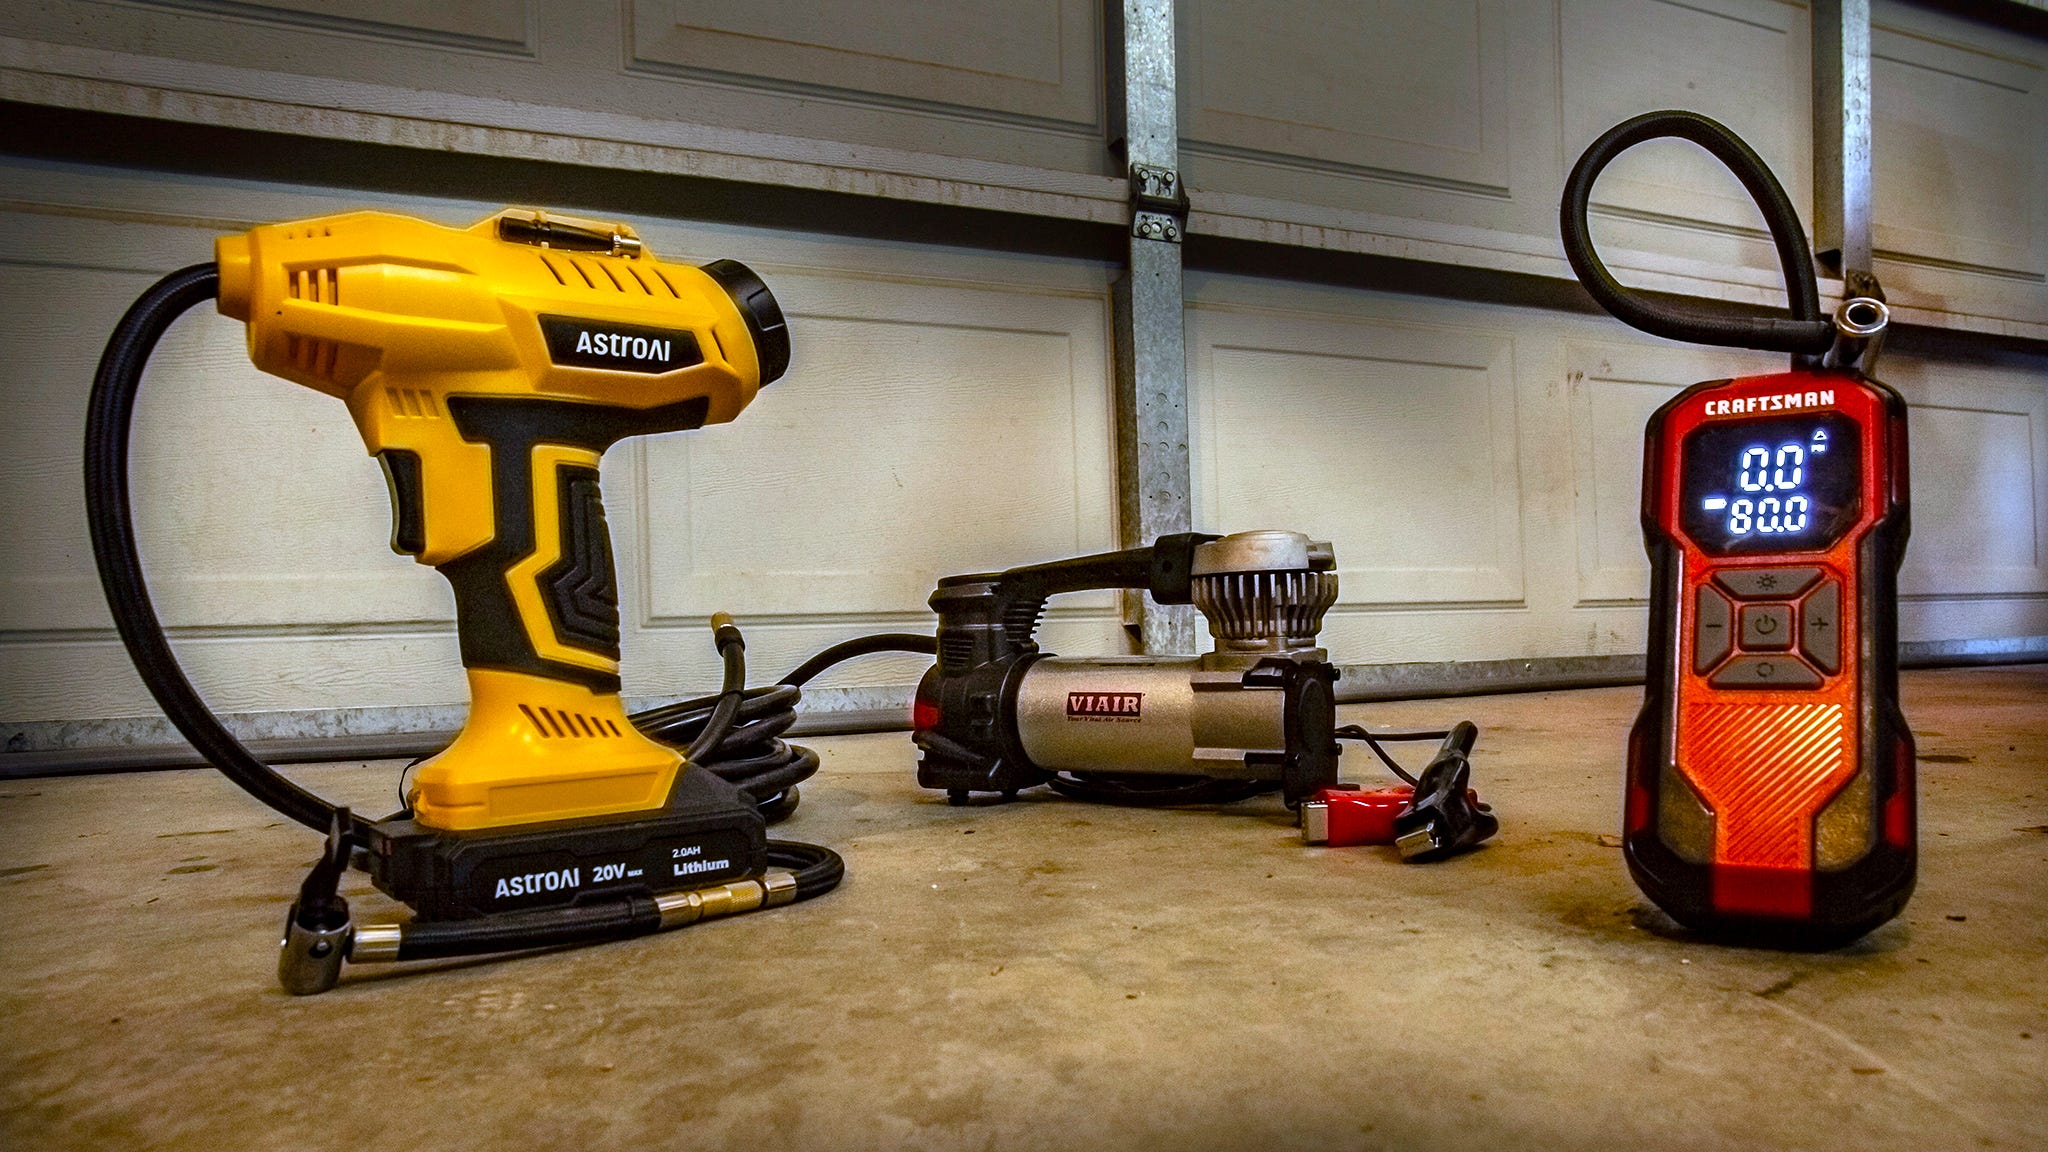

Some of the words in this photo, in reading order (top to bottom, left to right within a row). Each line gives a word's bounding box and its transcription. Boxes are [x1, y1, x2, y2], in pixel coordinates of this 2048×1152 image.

[1705, 390, 1835, 416] CRAFTSMAN
[1740, 445, 1804, 492] 0.0
[1070, 695, 1139, 713] VIAIR
[672, 845, 701, 859] 2.0AH
[592, 862, 626, 883] 20V
[673, 859, 729, 876] Lithium
